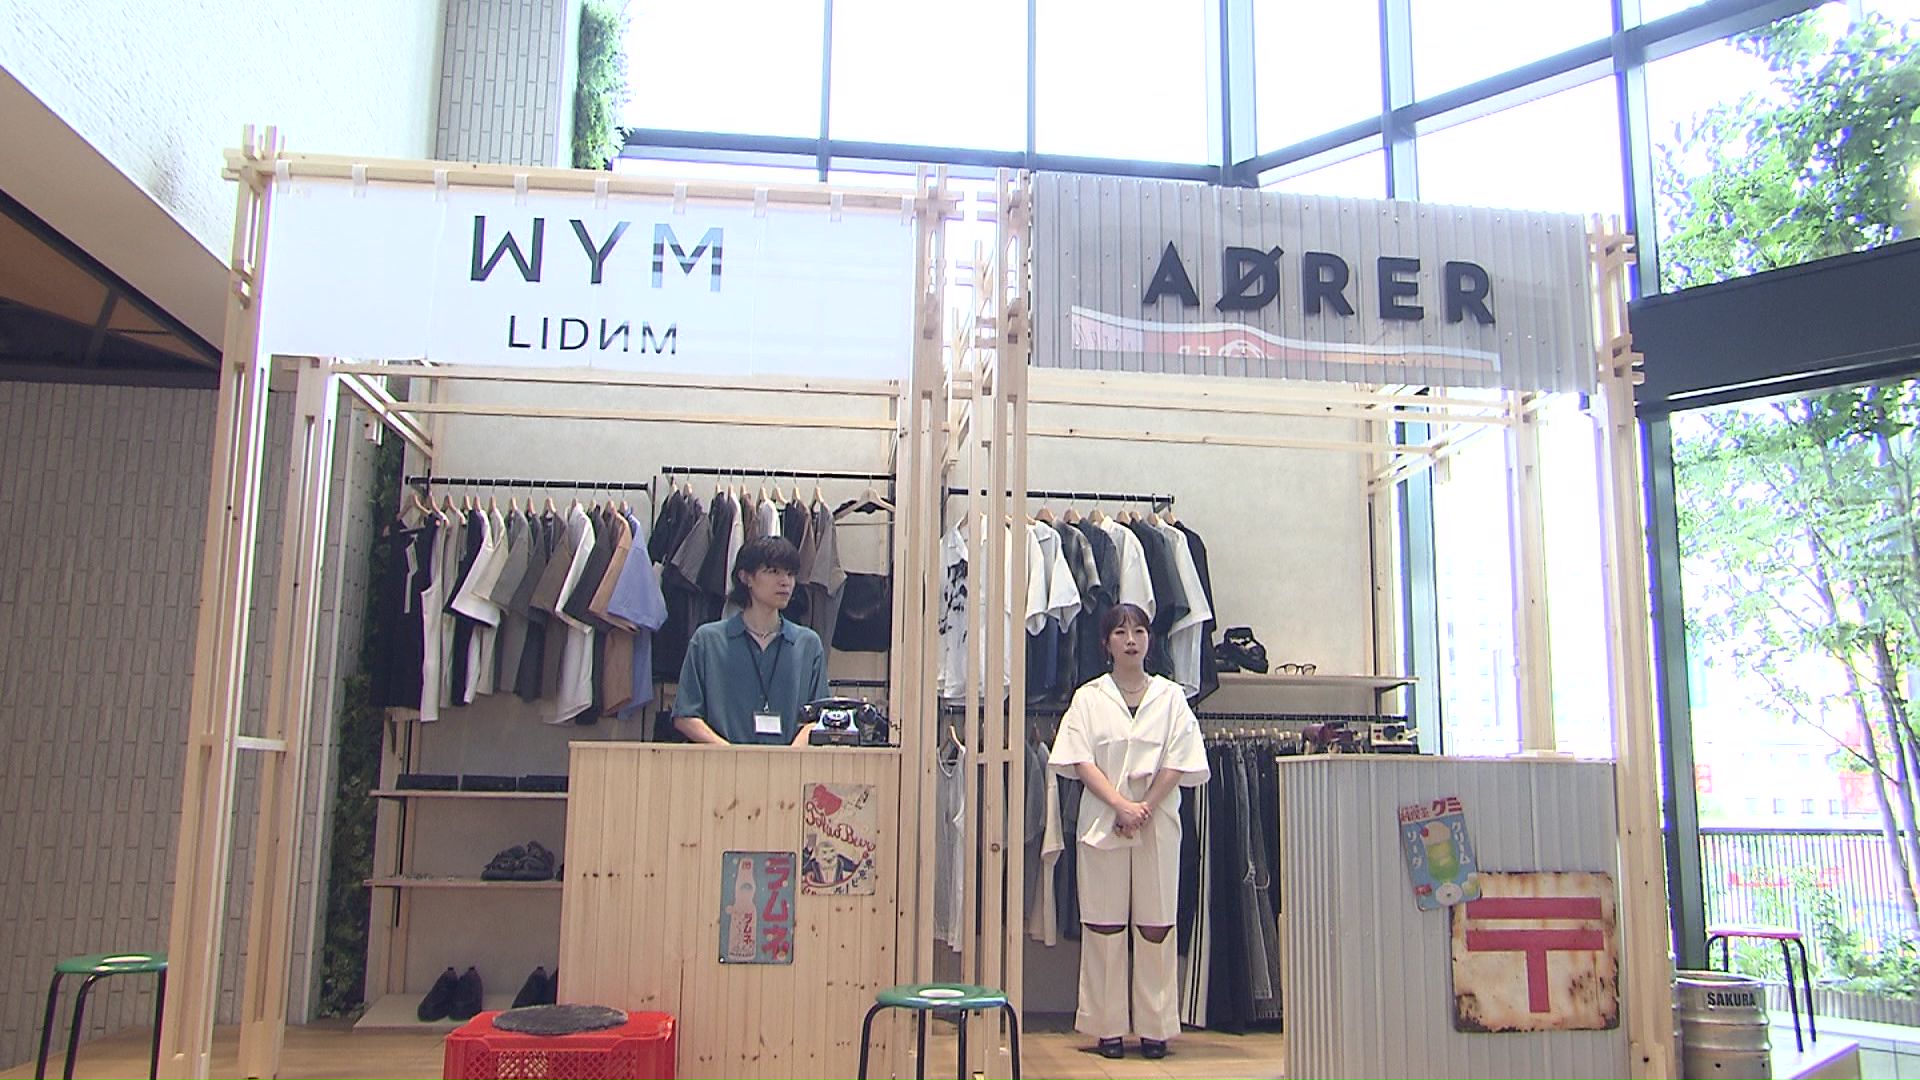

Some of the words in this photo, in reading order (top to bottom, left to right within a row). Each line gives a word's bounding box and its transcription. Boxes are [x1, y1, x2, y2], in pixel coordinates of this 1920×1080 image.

[761, 857, 790, 961] ラムネ
[1707, 991, 1757, 1007] SAKURA
